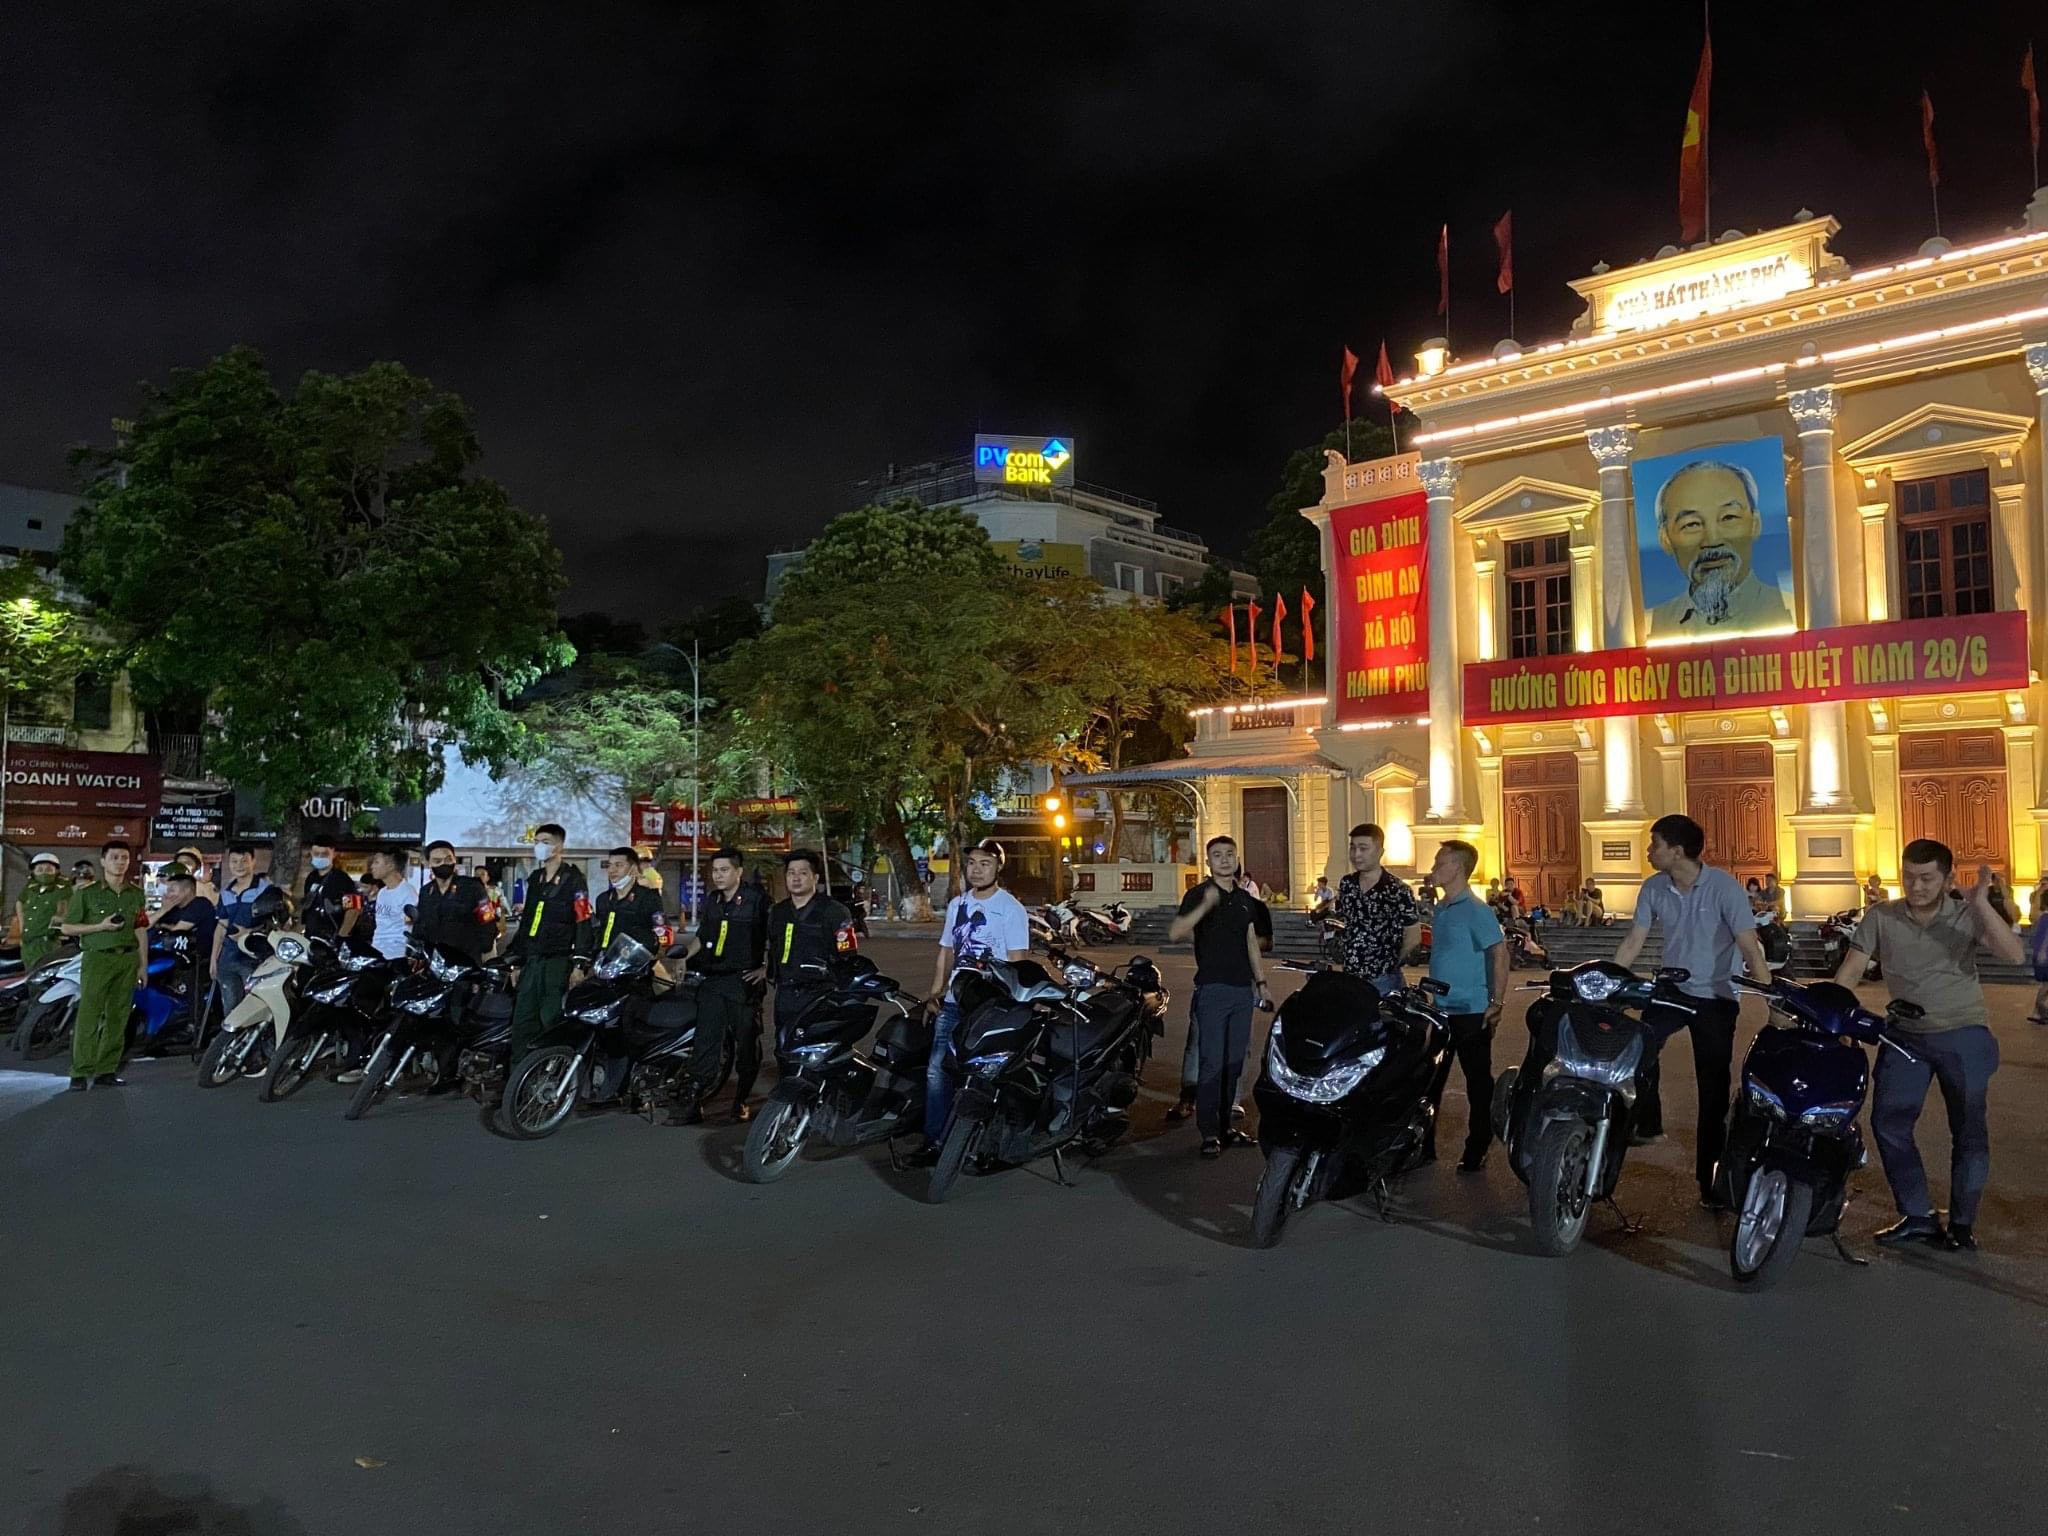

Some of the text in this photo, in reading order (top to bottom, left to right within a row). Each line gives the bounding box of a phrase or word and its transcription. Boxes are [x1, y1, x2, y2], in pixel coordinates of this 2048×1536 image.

[1654, 282, 1687, 310] HÁT
[1006, 466, 1052, 482] Bank
[1350, 515, 1420, 557] GIA ĐÌNH
[1356, 565, 1420, 603] BÌNH AN
[1364, 611, 1415, 650] XÃ HỘI
[1347, 668, 1390, 703] HẠNH
[1490, 635, 1988, 712] HƯỞNG ỨNG NGÀY GIA ĐÌNH VIỆT NAM 28/6
[76, 773, 141, 789] WATCH
